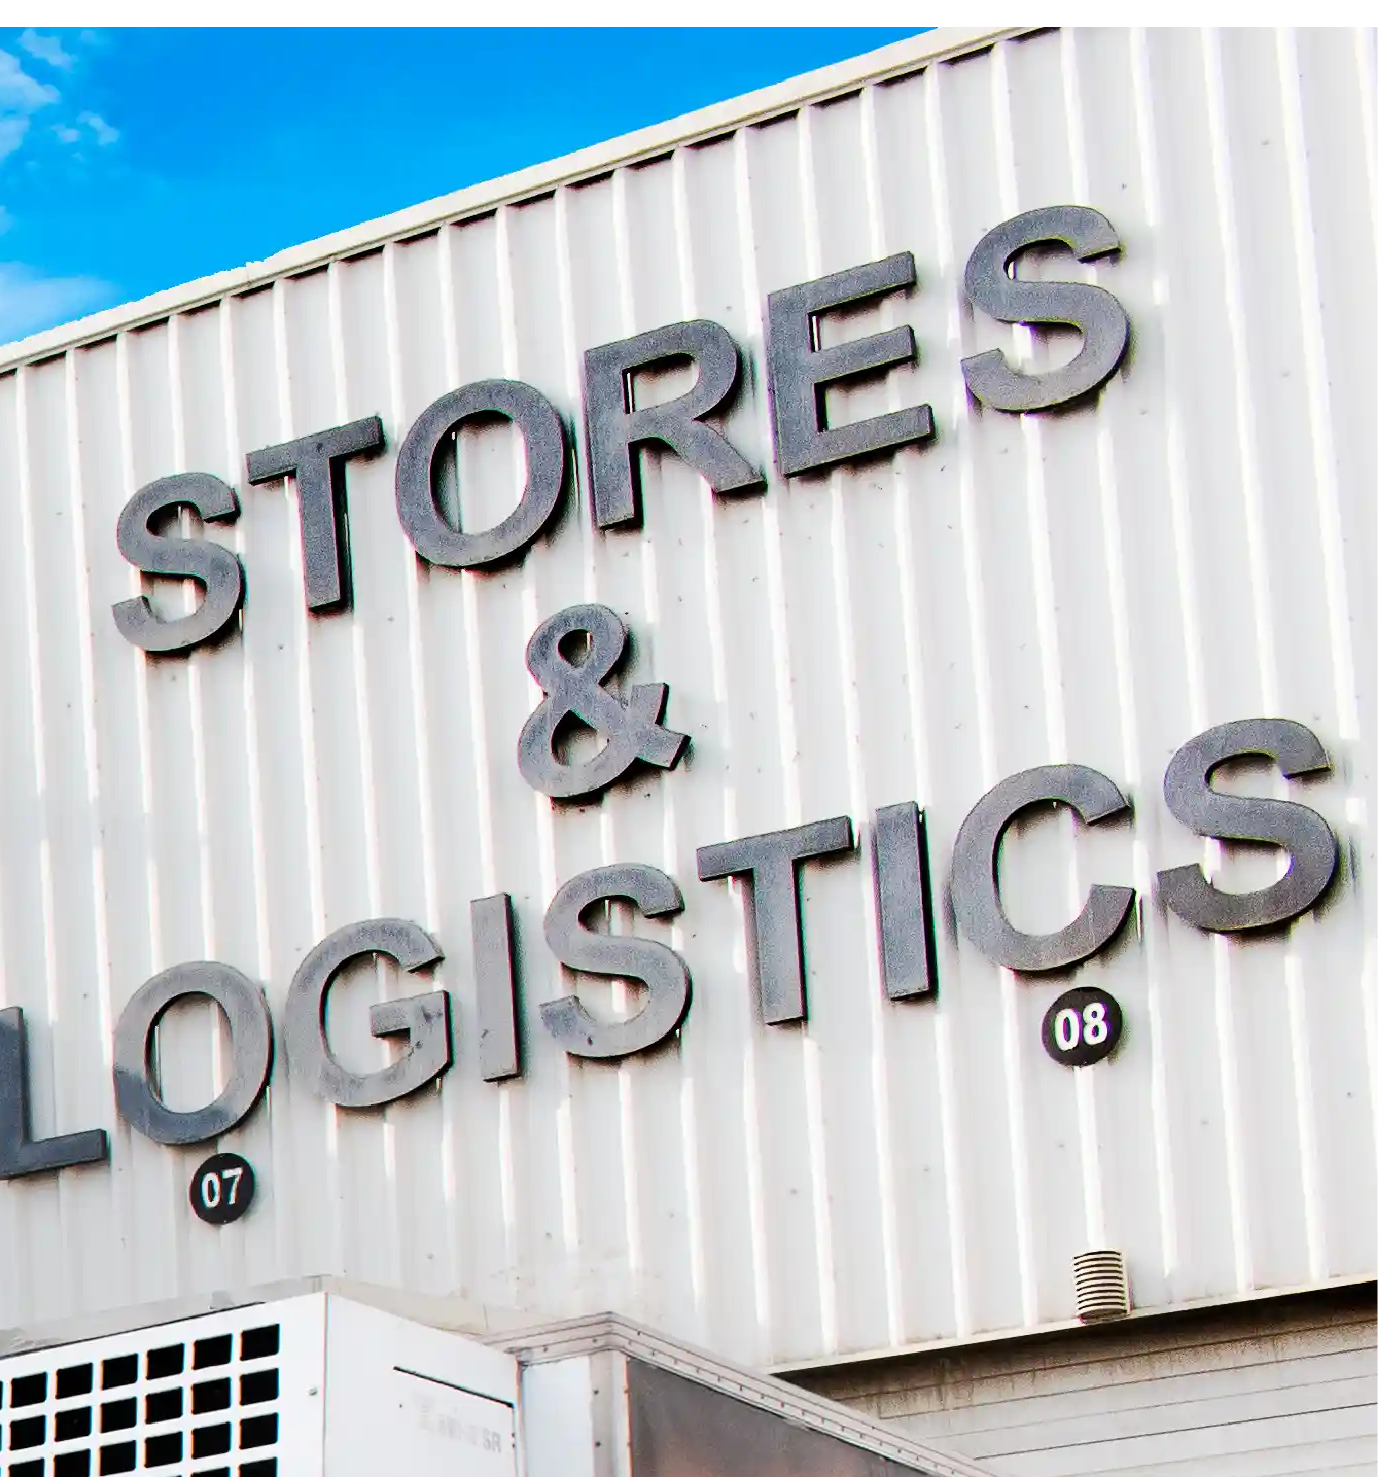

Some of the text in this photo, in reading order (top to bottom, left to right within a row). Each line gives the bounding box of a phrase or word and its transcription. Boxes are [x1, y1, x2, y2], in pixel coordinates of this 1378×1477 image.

[111, 203, 1133, 656] STORES
[516, 602, 692, 800] &
[1054, 1002, 1108, 1051] 08
[201, 1166, 243, 1208] 07
